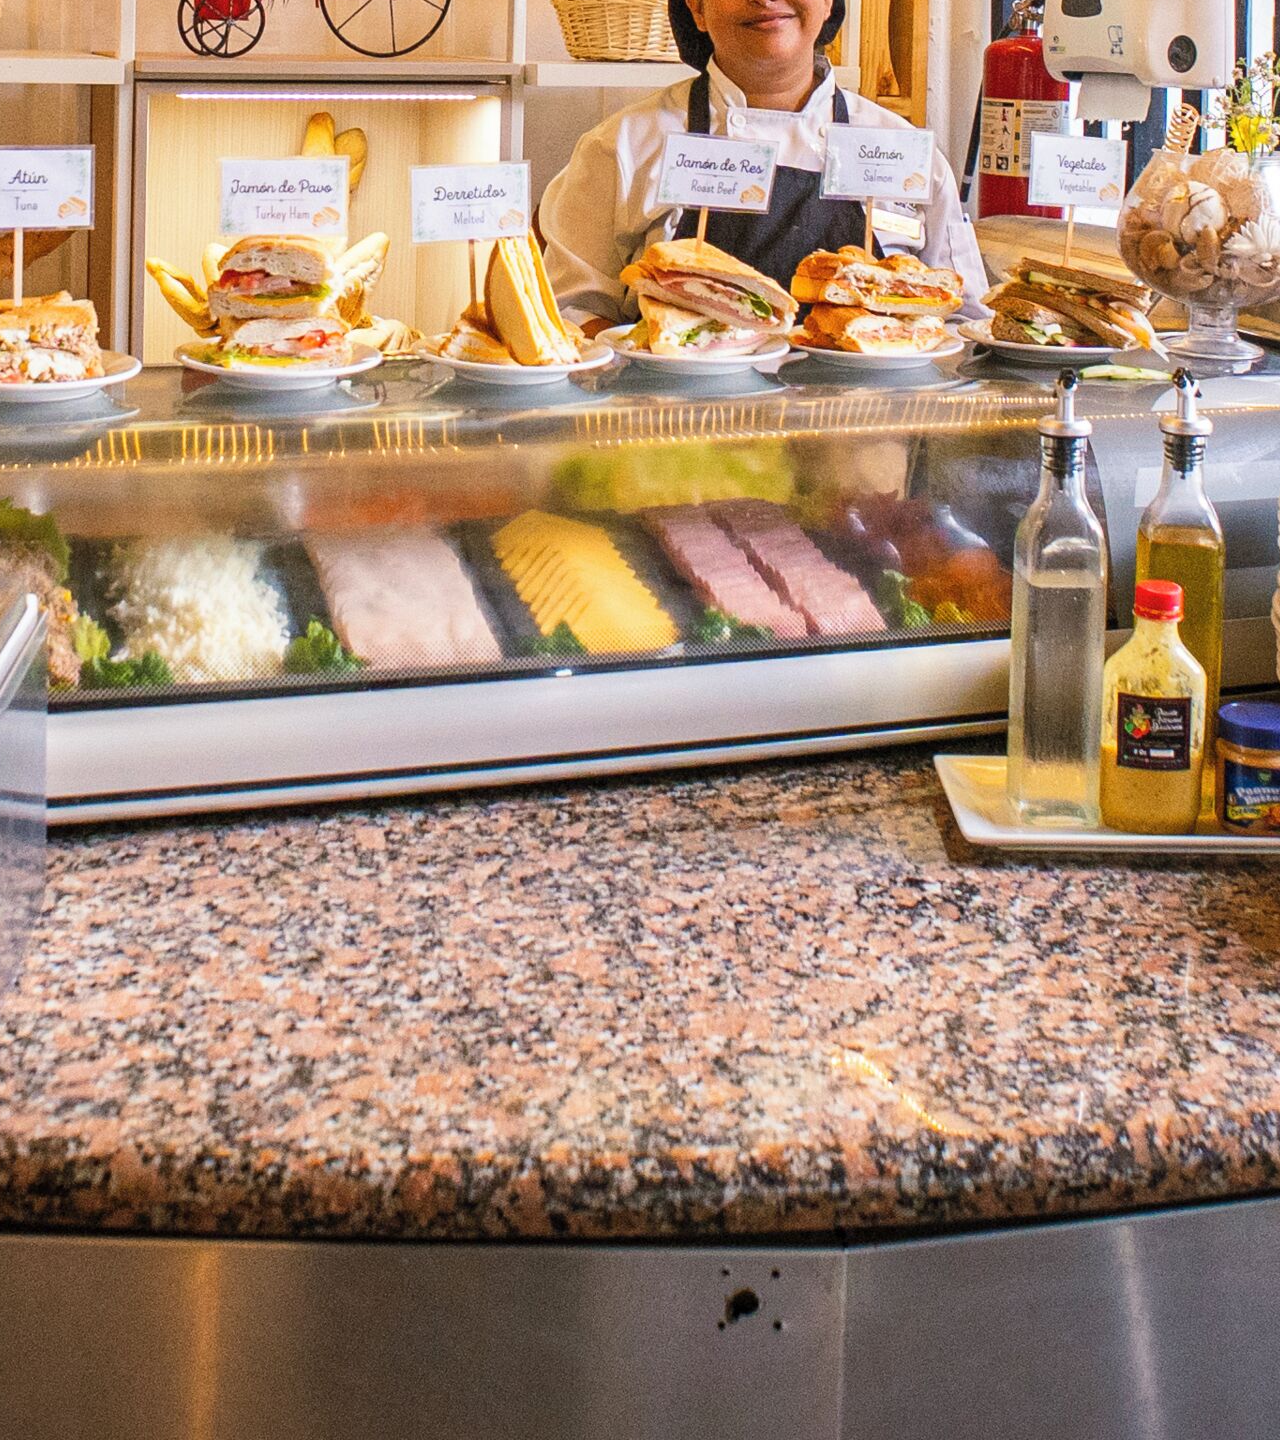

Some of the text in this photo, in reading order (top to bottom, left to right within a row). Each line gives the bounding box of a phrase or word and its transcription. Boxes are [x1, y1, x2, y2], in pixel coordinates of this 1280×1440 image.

[858, 144, 904, 161] Salmón
[676, 152, 764, 174] Jamón de Res
[1056, 154, 1107, 173] Vegetales
[8, 169, 49, 184] Atún
[863, 168, 893, 183] Salmon
[230, 179, 333, 194] Jamón de Pavo
[433, 183, 507, 201] Derretidos
[690, 179, 738, 195] Roast Beef
[1058, 177, 1097, 195] Vegetables
[14, 196, 39, 211] Tuna
[255, 205, 310, 223] Turkey Ham
[453, 209, 485, 225] Melted
